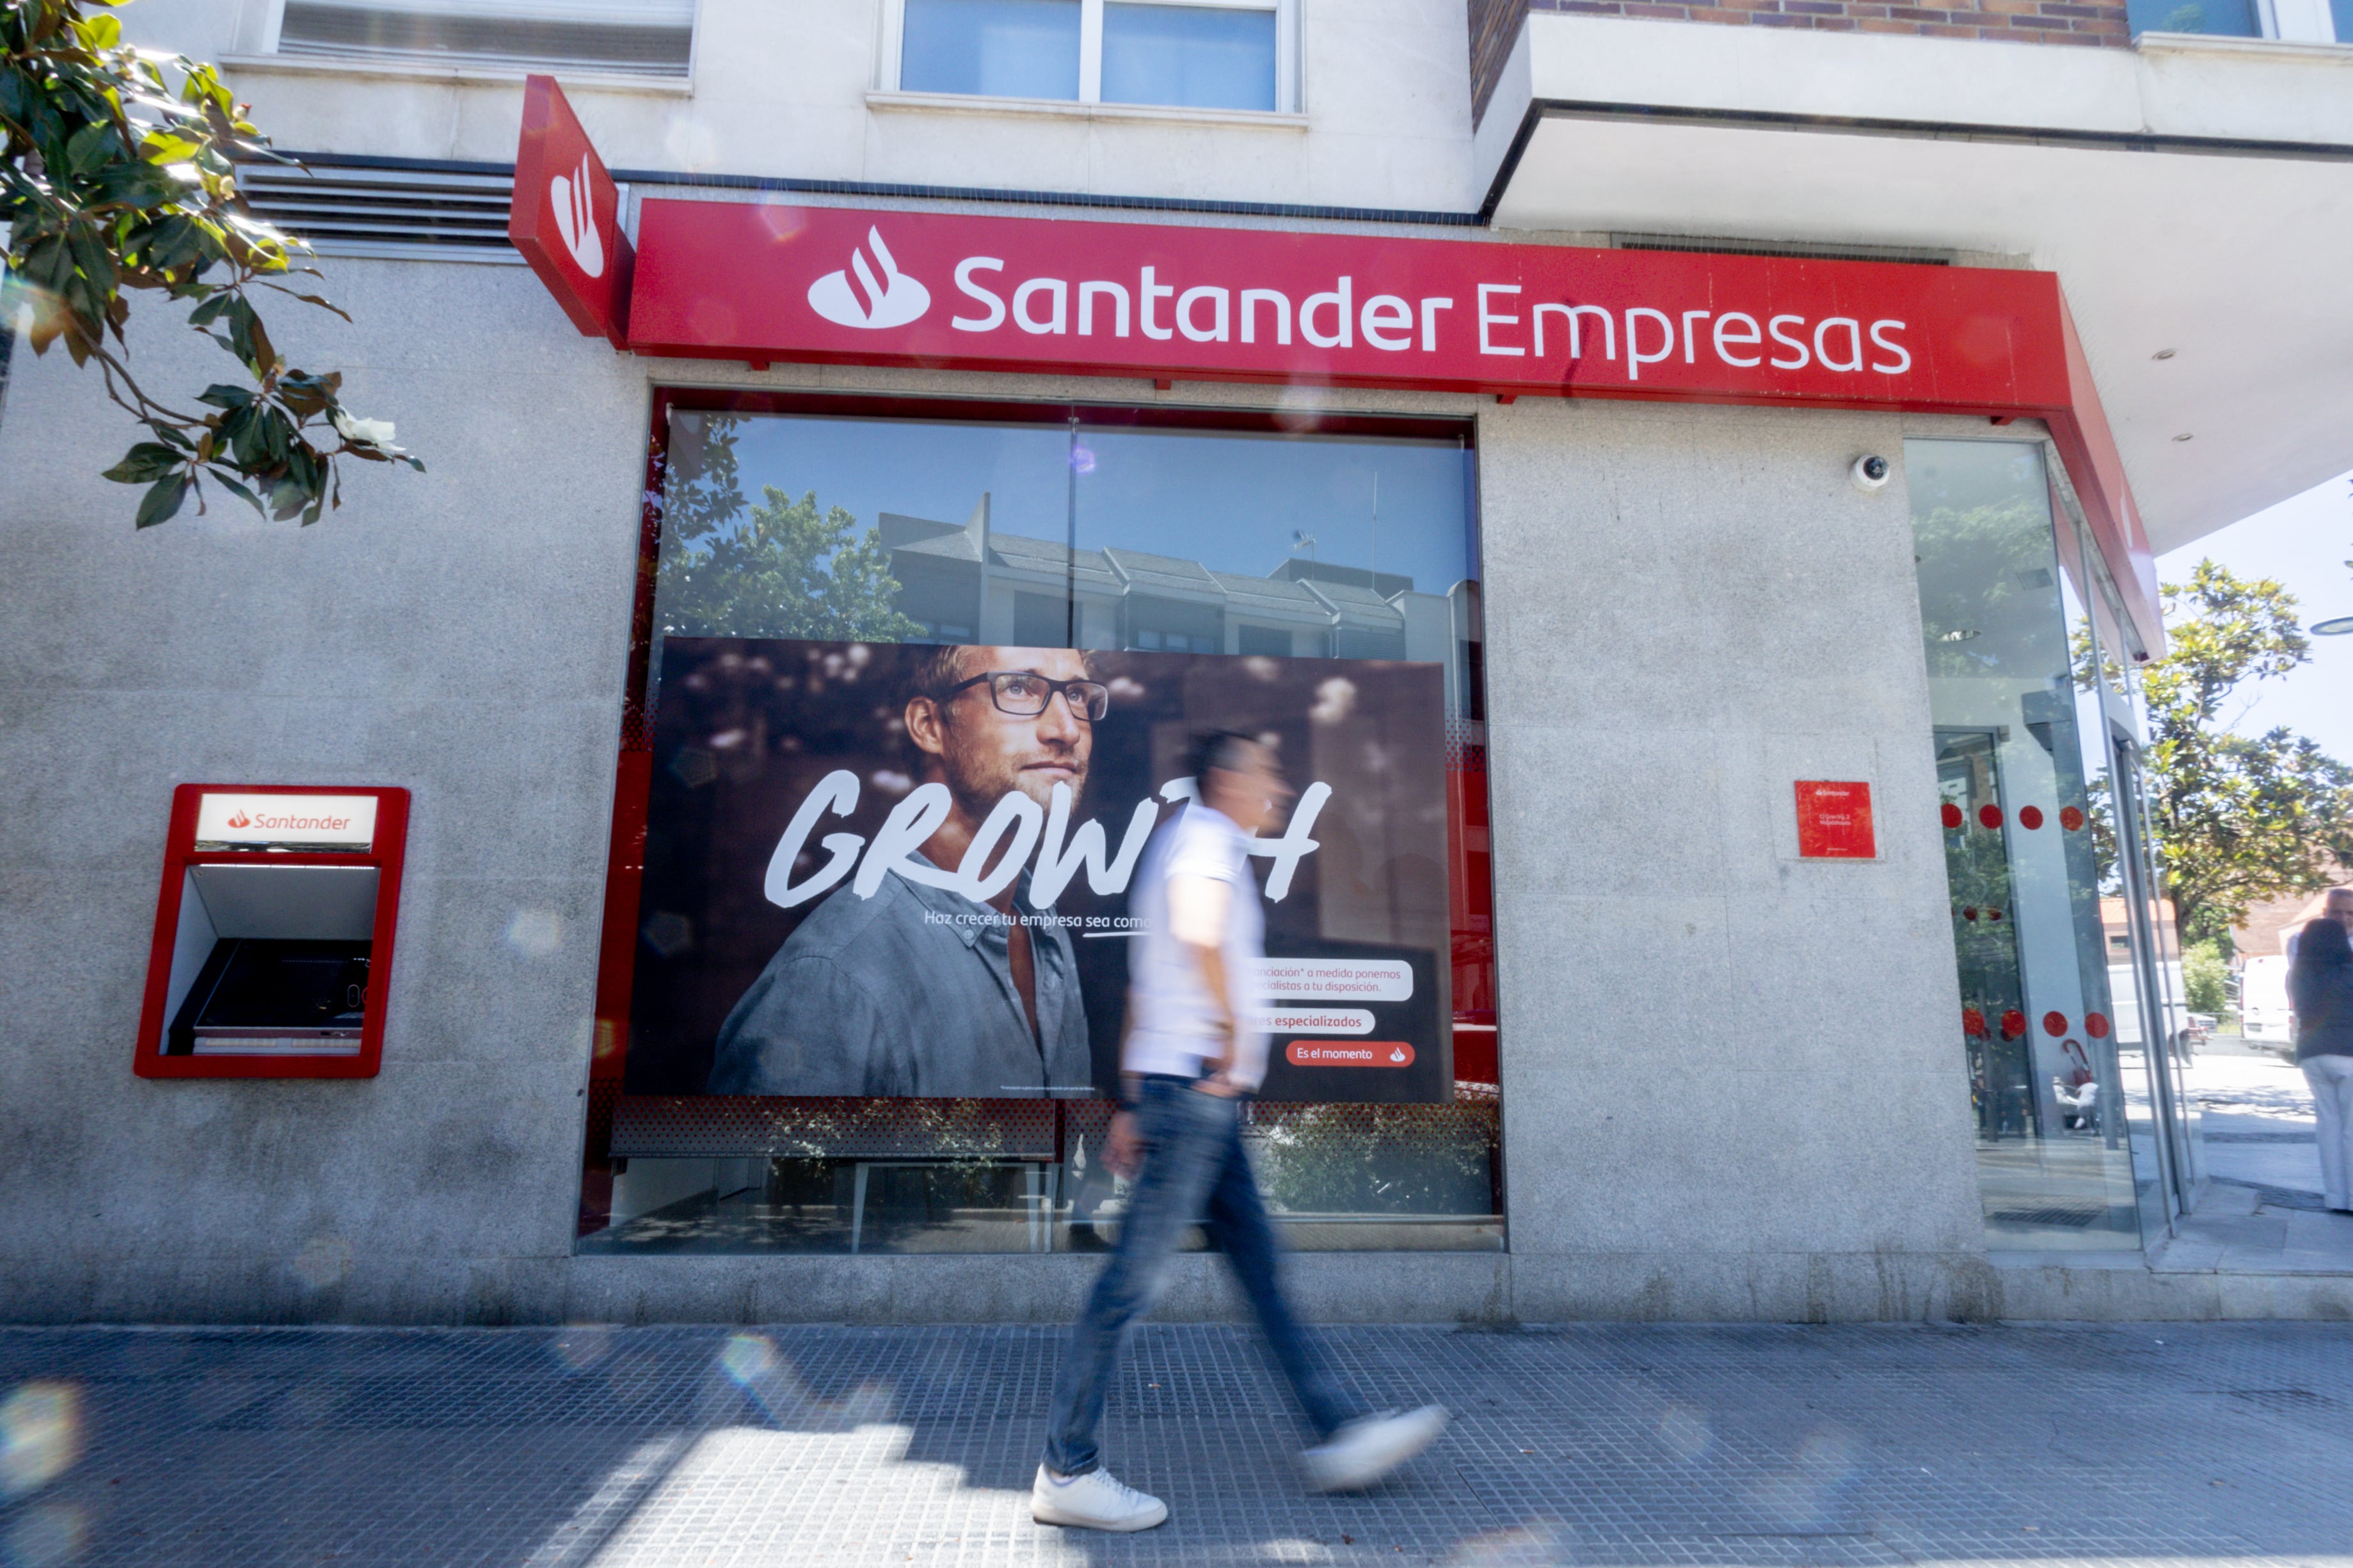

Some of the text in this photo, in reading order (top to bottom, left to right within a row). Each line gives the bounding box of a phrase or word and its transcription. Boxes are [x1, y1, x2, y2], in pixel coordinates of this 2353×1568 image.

[952, 256, 1911, 380] Santander Empresas
[253, 814, 351, 830] Santander
[765, 770, 1332, 909] GROWH
[924, 911, 1151, 930] Haz crecer tu empresa sea como
[1316, 967, 1353, 979] medida
[1355, 970, 1401, 979] ponemos
[1304, 983, 1310, 991] a
[1312, 981, 1323, 991] tu
[1325, 980, 1382, 993] disposición.
[1275, 1015, 1361, 1029] especializados
[1297, 1048, 1373, 1059] Es el momento
